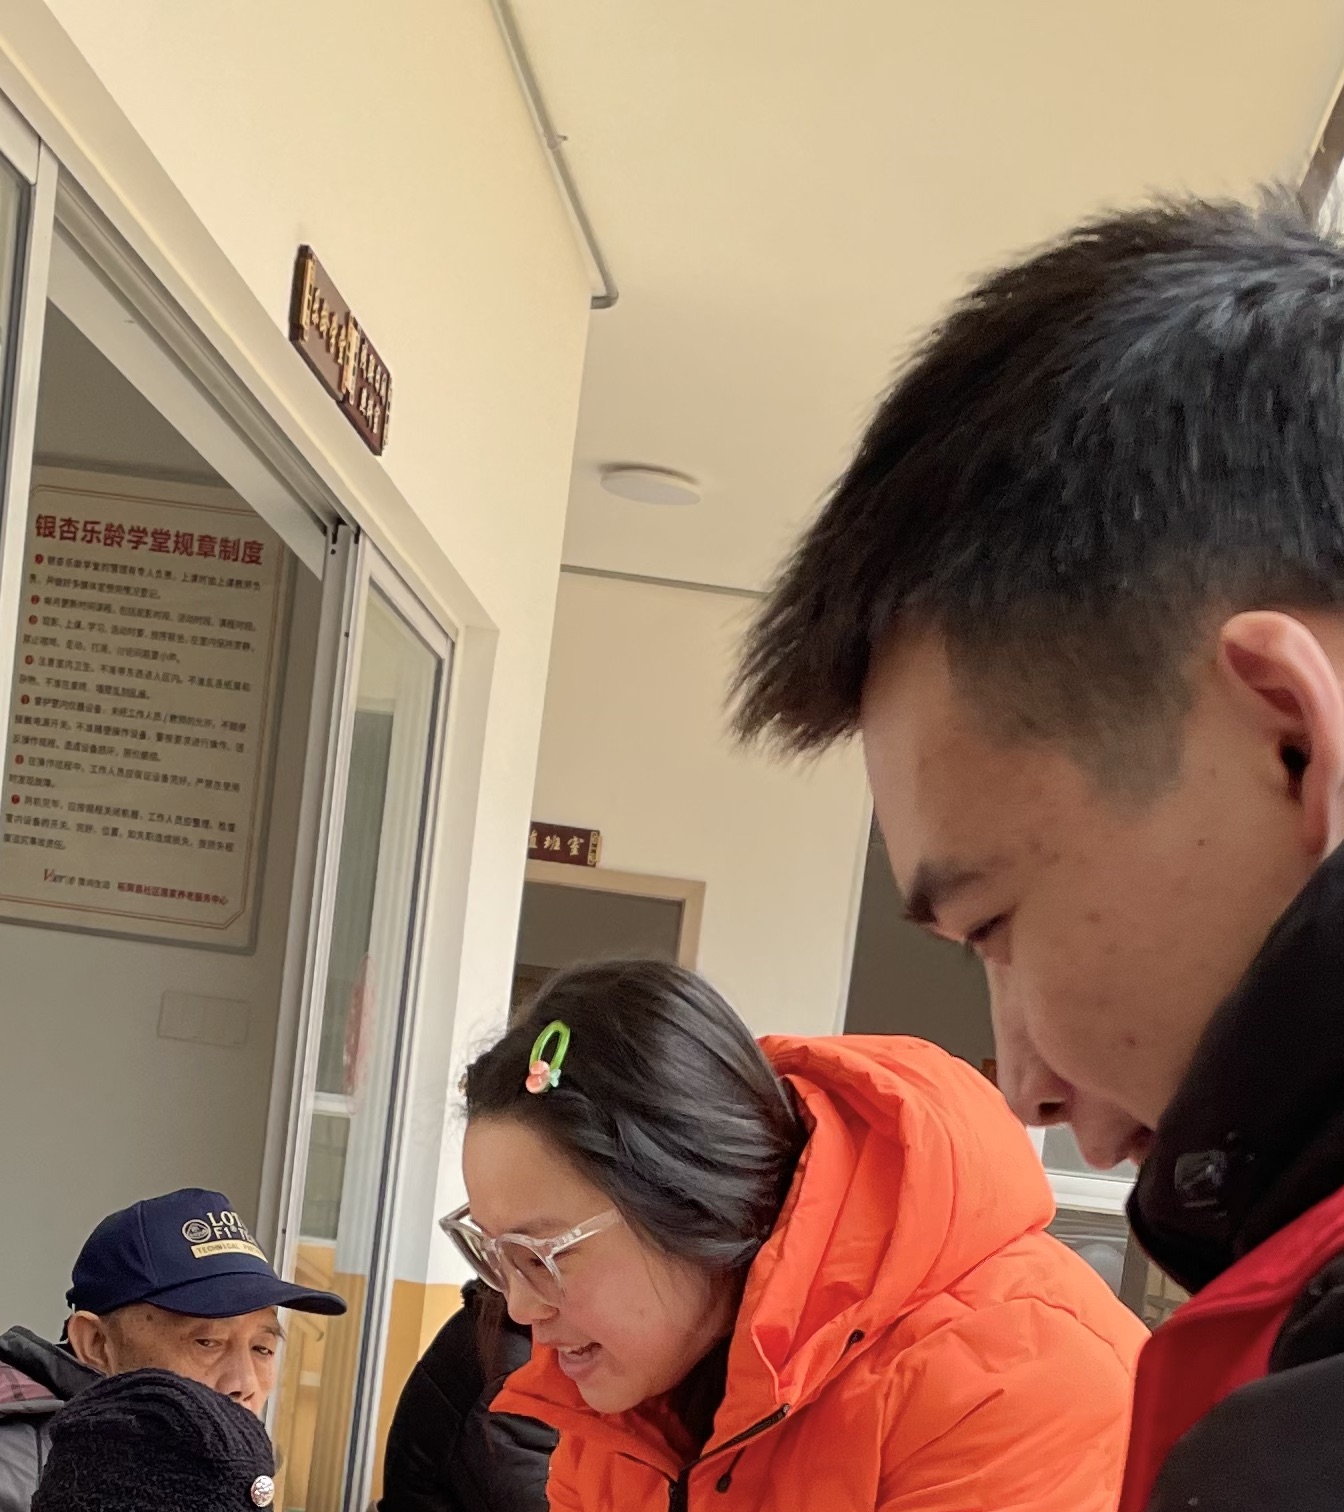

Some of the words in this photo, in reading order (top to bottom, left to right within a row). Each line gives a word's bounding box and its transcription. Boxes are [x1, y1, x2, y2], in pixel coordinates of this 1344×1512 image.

[35, 513, 265, 566] 银杏乐龄学堂规章制度
